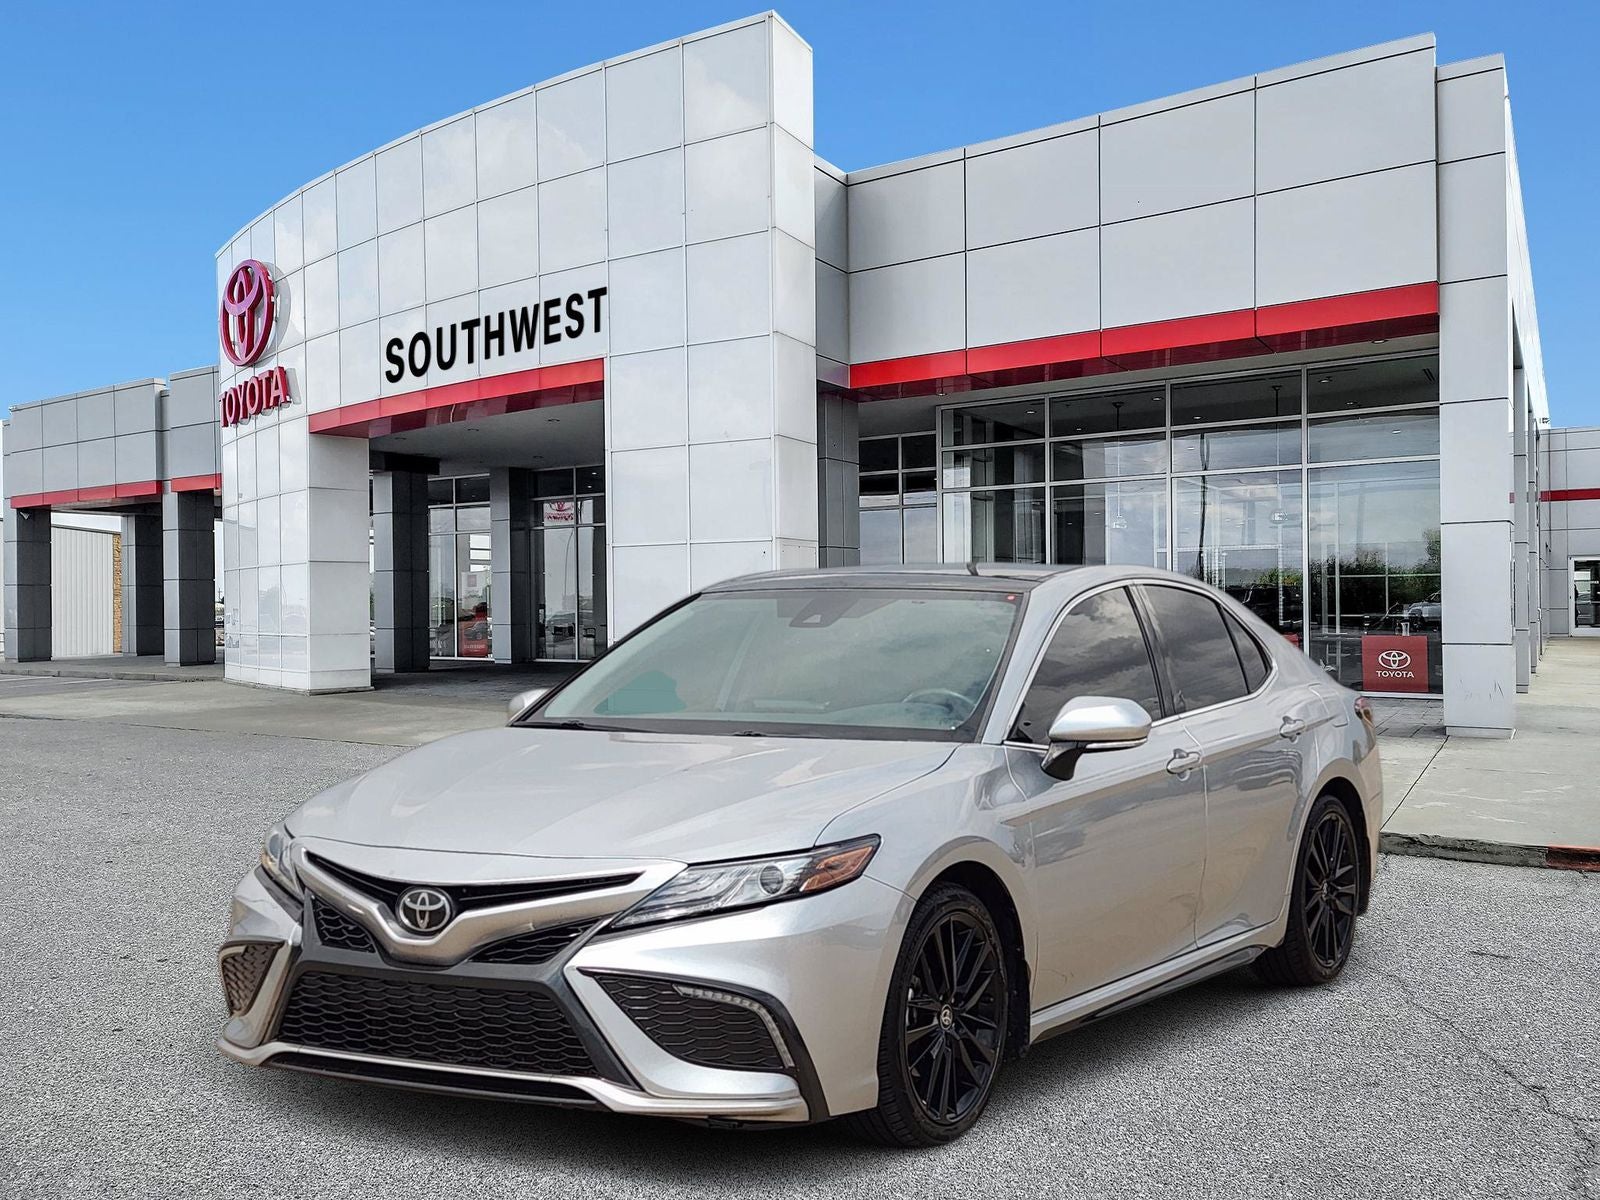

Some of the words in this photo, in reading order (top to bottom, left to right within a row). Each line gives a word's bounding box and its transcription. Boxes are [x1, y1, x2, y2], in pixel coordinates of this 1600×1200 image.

[385, 287, 607, 383] SOUTHWEST
[219, 366, 288, 427] TOYOTA
[1375, 670, 1415, 678] TOYOTA
